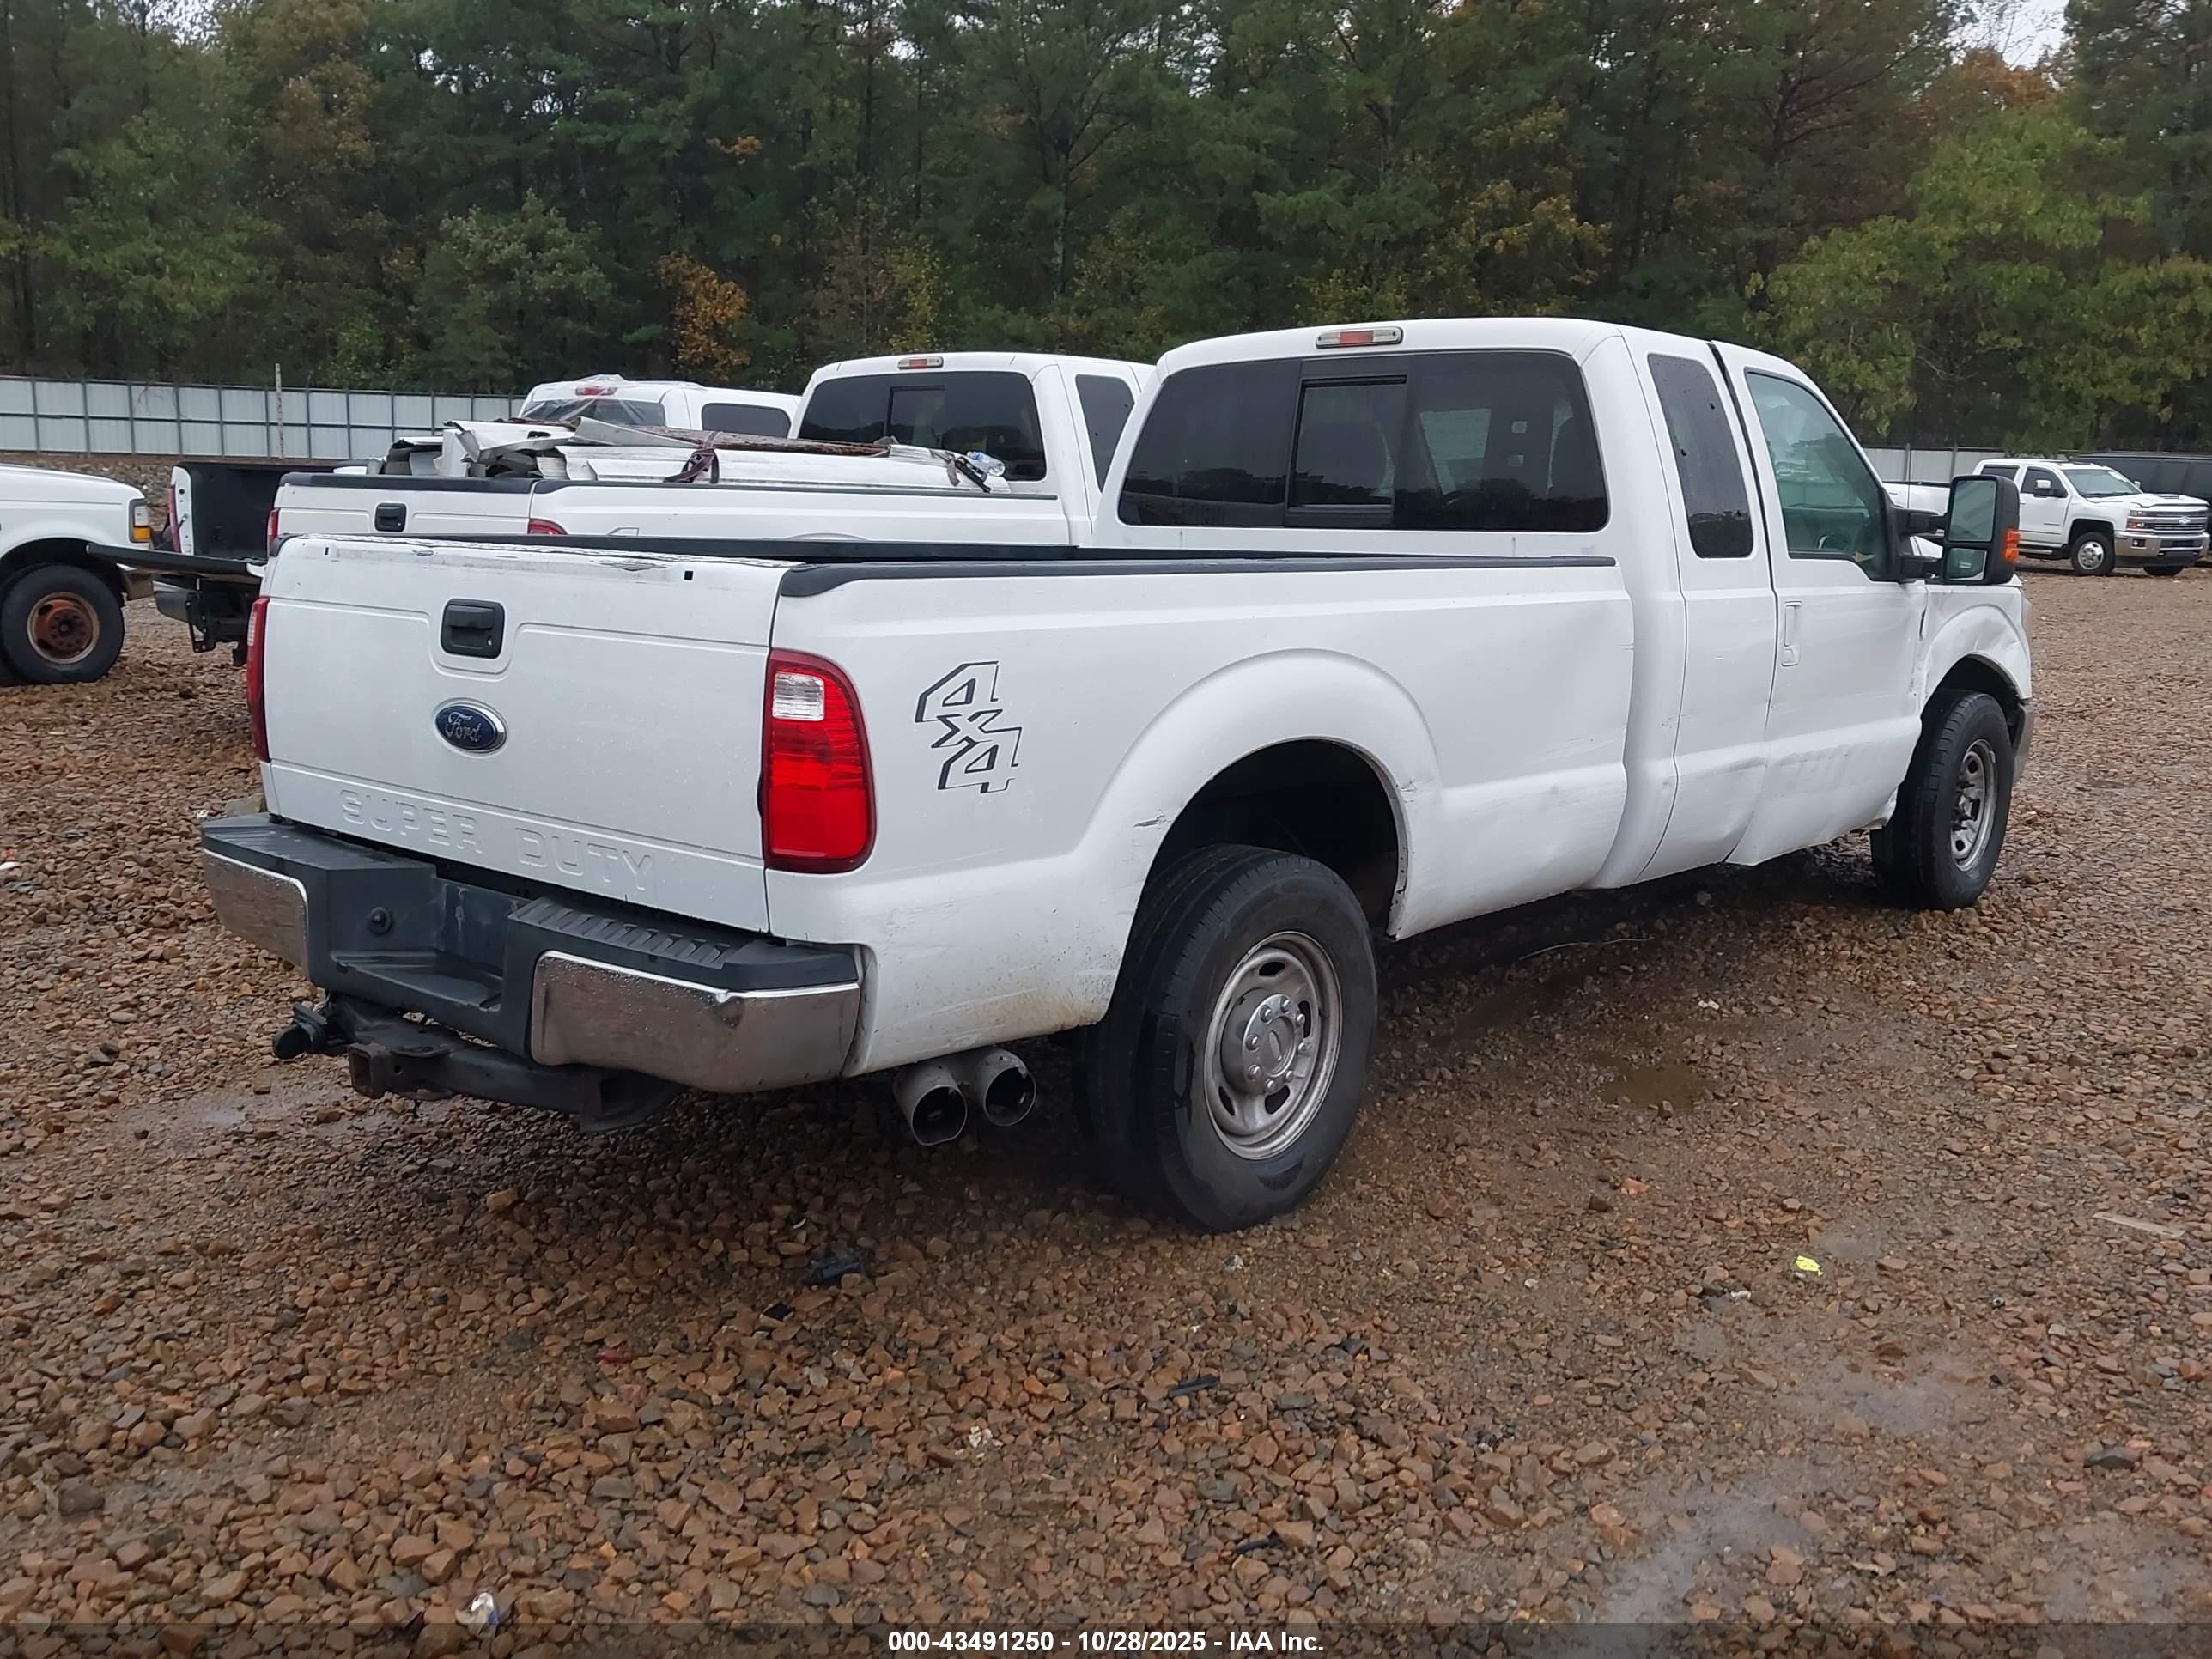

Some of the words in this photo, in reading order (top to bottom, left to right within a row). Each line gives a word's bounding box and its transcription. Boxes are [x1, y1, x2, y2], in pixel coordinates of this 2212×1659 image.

[445, 711, 482, 743] Ford
[339, 789, 483, 854] SUPER
[514, 827, 652, 891] DUTY
